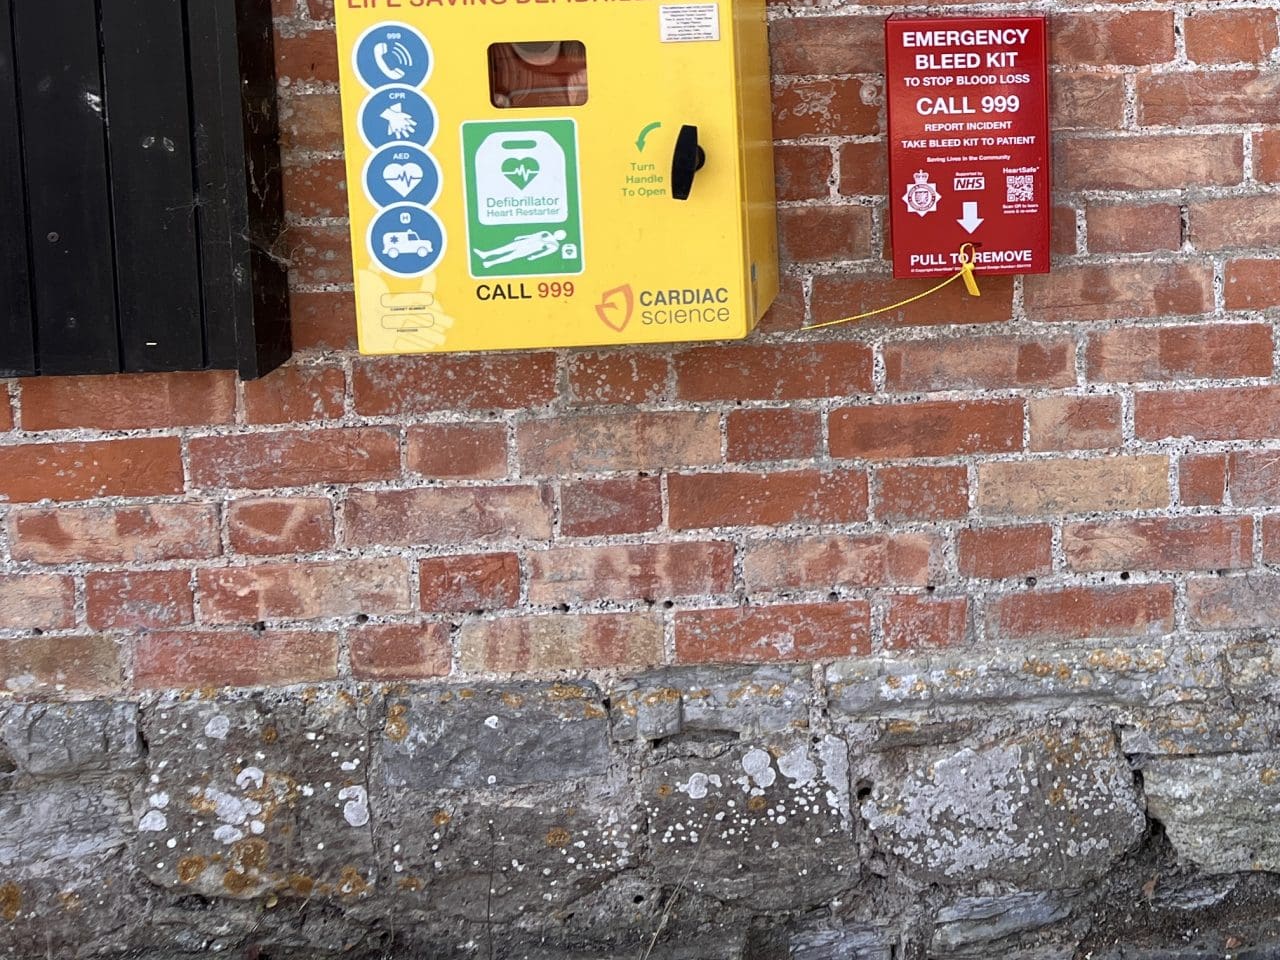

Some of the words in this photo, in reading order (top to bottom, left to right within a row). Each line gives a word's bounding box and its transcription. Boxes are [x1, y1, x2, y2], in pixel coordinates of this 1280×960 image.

[386, 32, 402, 40] 999
[902, 28, 1030, 48] EMERGENCY
[915, 53, 981, 70] BLEED
[986, 51, 1019, 68] KIT
[903, 77, 920, 87] TO
[922, 76, 954, 87] STOP
[956, 75, 997, 86] BLOOD
[999, 74, 1030, 85] LOSS
[388, 92, 406, 100] CPR
[916, 96, 976, 115] CALL
[981, 95, 1020, 113] 999
[924, 123, 965, 132] REPORT
[966, 121, 1013, 131] INCIDENT
[901, 140, 927, 149] TAKE
[929, 139, 961, 148] BLEED
[963, 138, 980, 147] KIT
[981, 137, 995, 146] TO
[997, 136, 1036, 145] PATIENT
[392, 152, 410, 161] AED
[979, 154, 1011, 162] Community
[630, 162, 655, 171] Turn
[625, 175, 664, 184] Handle
[956, 178, 984, 190] NHS
[622, 187, 635, 197] To
[637, 187, 666, 198] Open
[486, 196, 560, 208] Defibrillator
[486, 209, 513, 218] Heart
[515, 208, 560, 217] Restarter
[910, 253, 947, 266] PULL
[950, 252, 969, 264] TO
[974, 250, 1033, 263] REMOVE
[476, 283, 532, 301] CALL
[537, 281, 575, 298] 999
[639, 287, 729, 307] CARDIAC
[641, 307, 730, 325] science
